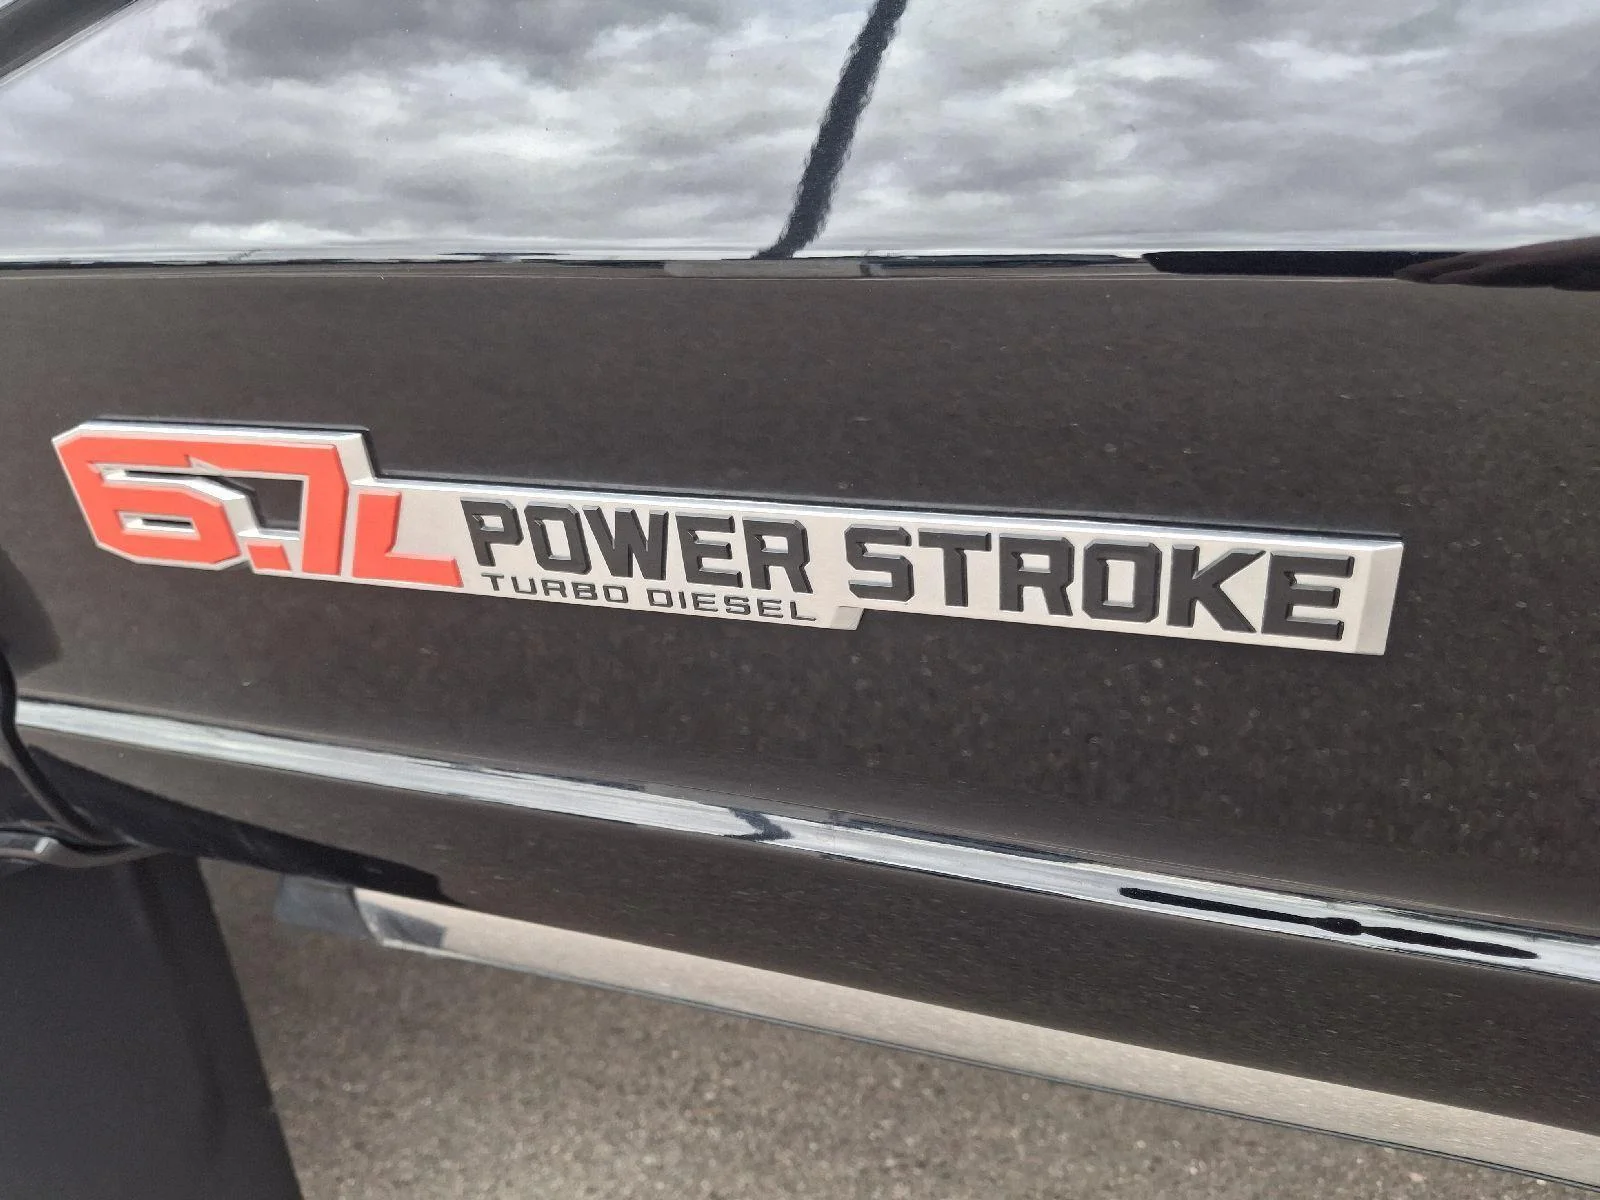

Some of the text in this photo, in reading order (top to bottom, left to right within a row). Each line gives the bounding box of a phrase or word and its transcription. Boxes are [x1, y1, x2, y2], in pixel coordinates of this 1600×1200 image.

[56, 435, 1355, 641] 6.7L POWER STROKE
[480, 572, 817, 622] TURBO DIESEL
